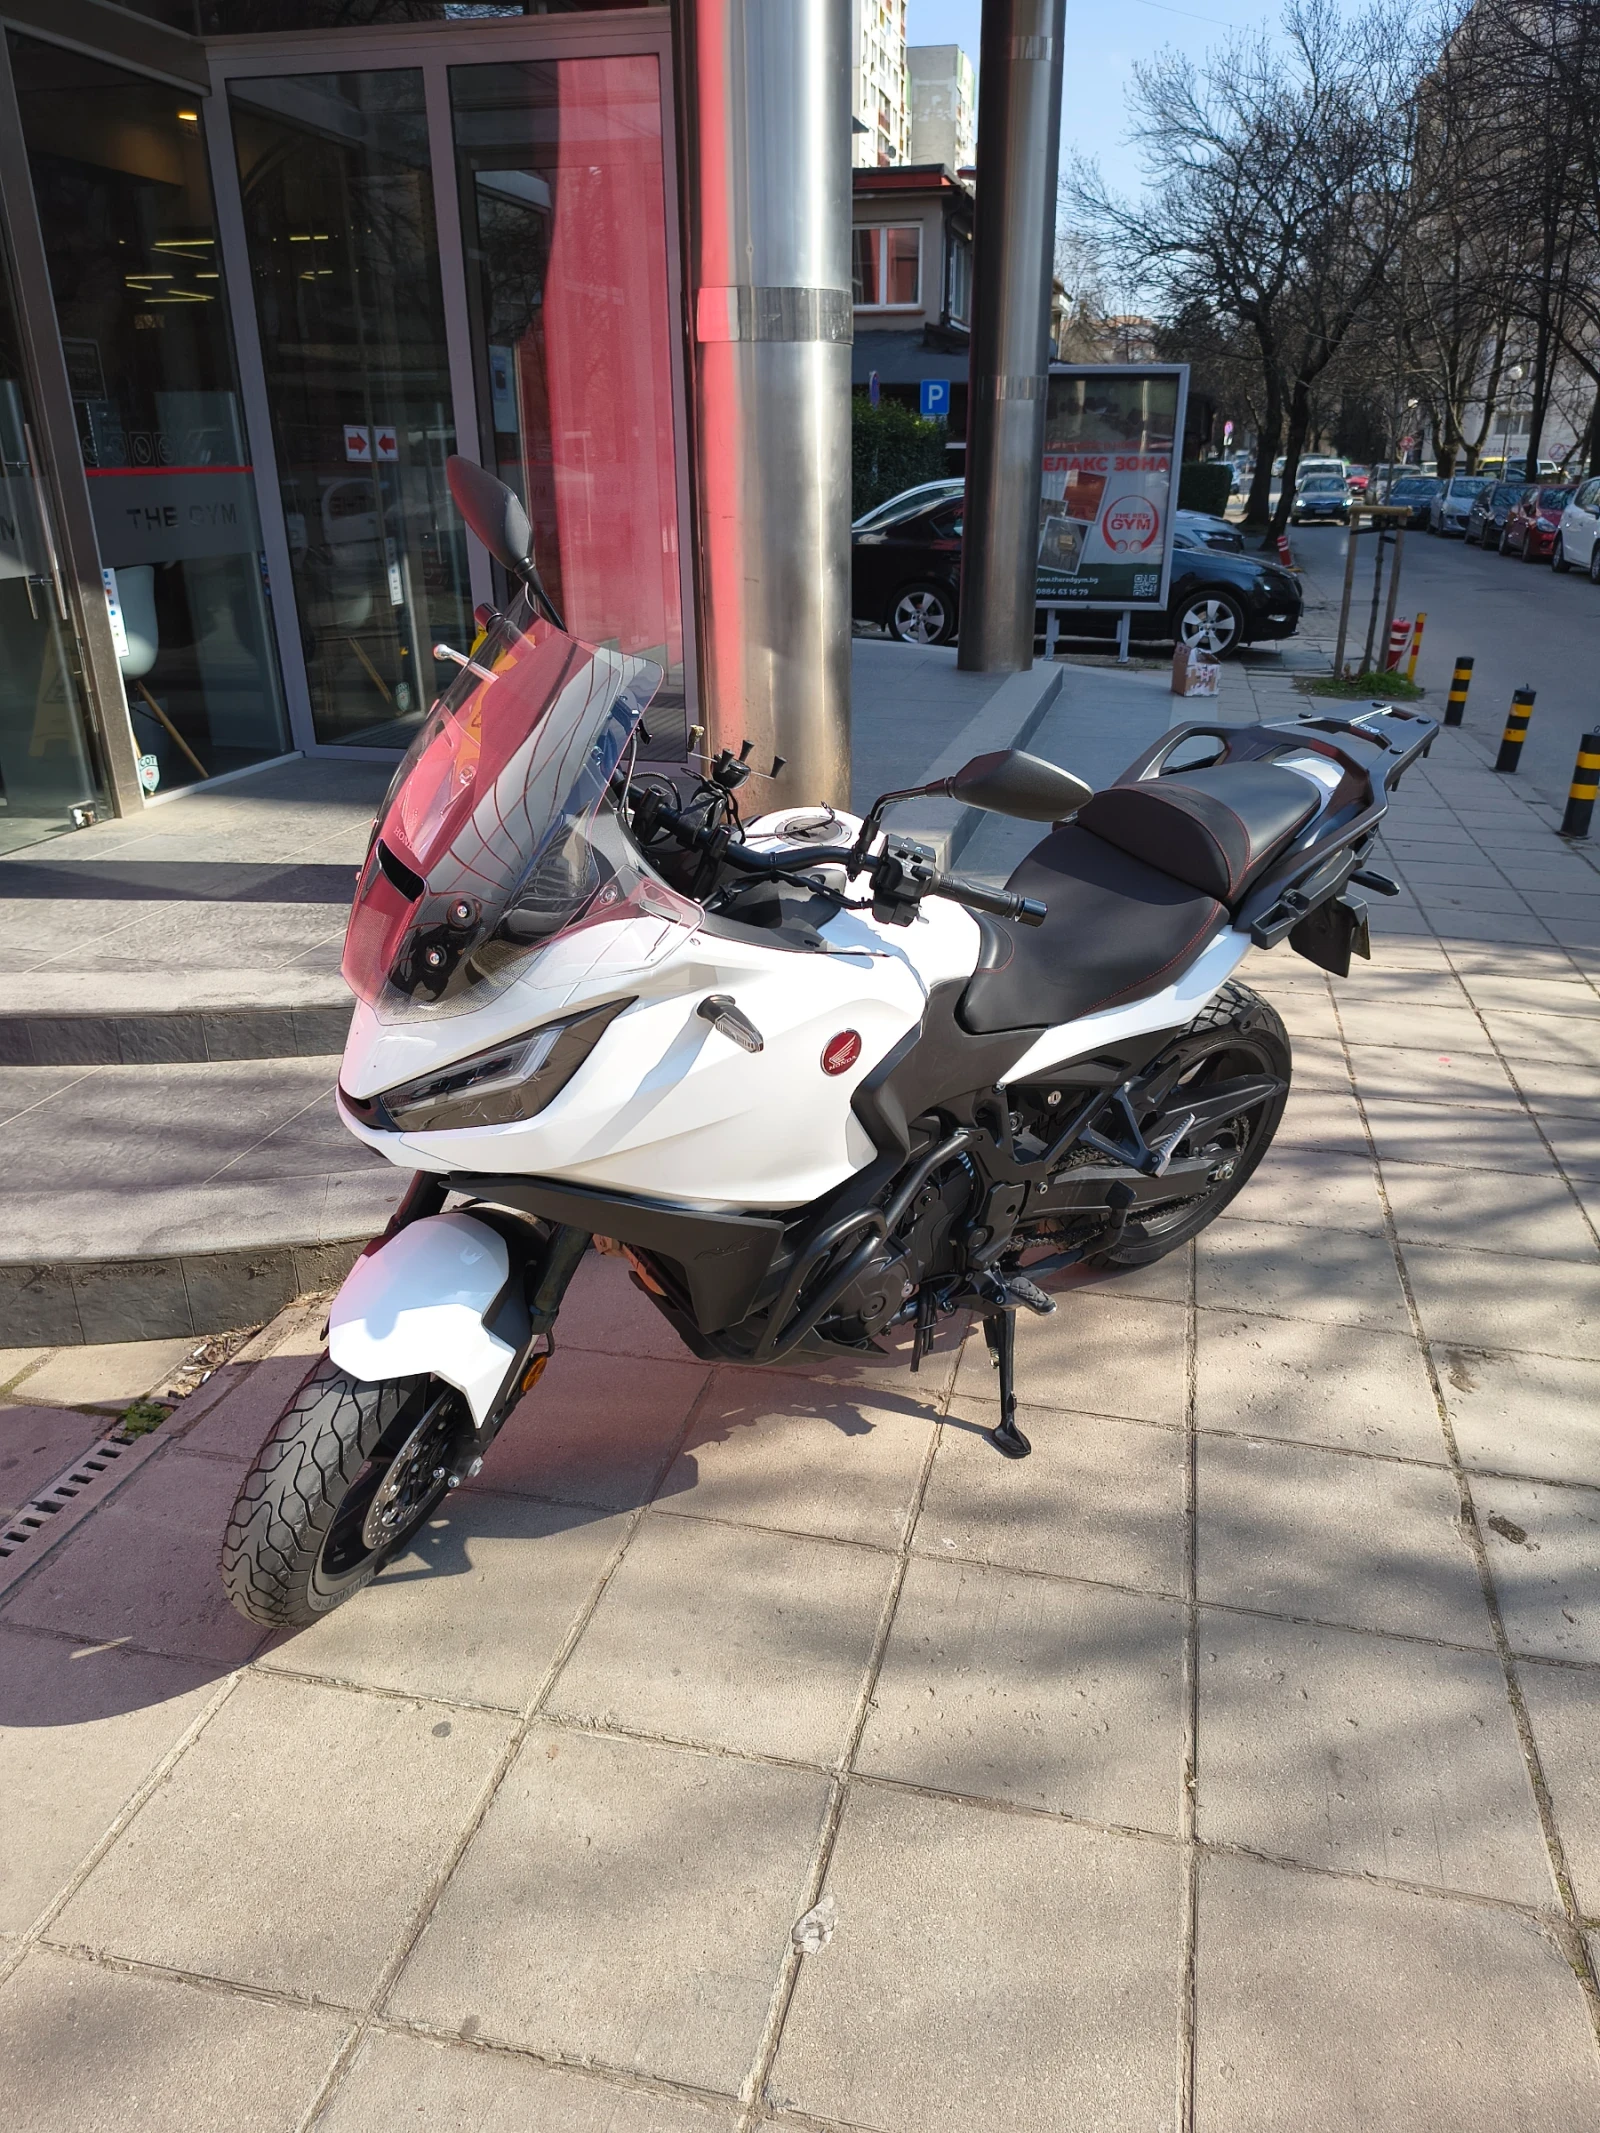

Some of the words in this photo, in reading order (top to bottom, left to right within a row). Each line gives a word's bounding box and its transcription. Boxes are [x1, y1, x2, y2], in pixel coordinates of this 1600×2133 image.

[928, 385, 943, 409] P
[1042, 456, 1109, 471] ЕЛАКС
[1114, 456, 1169, 471] ЗОНА
[126, 507, 178, 530] THE
[189, 502, 238, 526] GYM
[1111, 519, 1150, 530] GYM
[828, 1055, 858, 1070] HONDA
